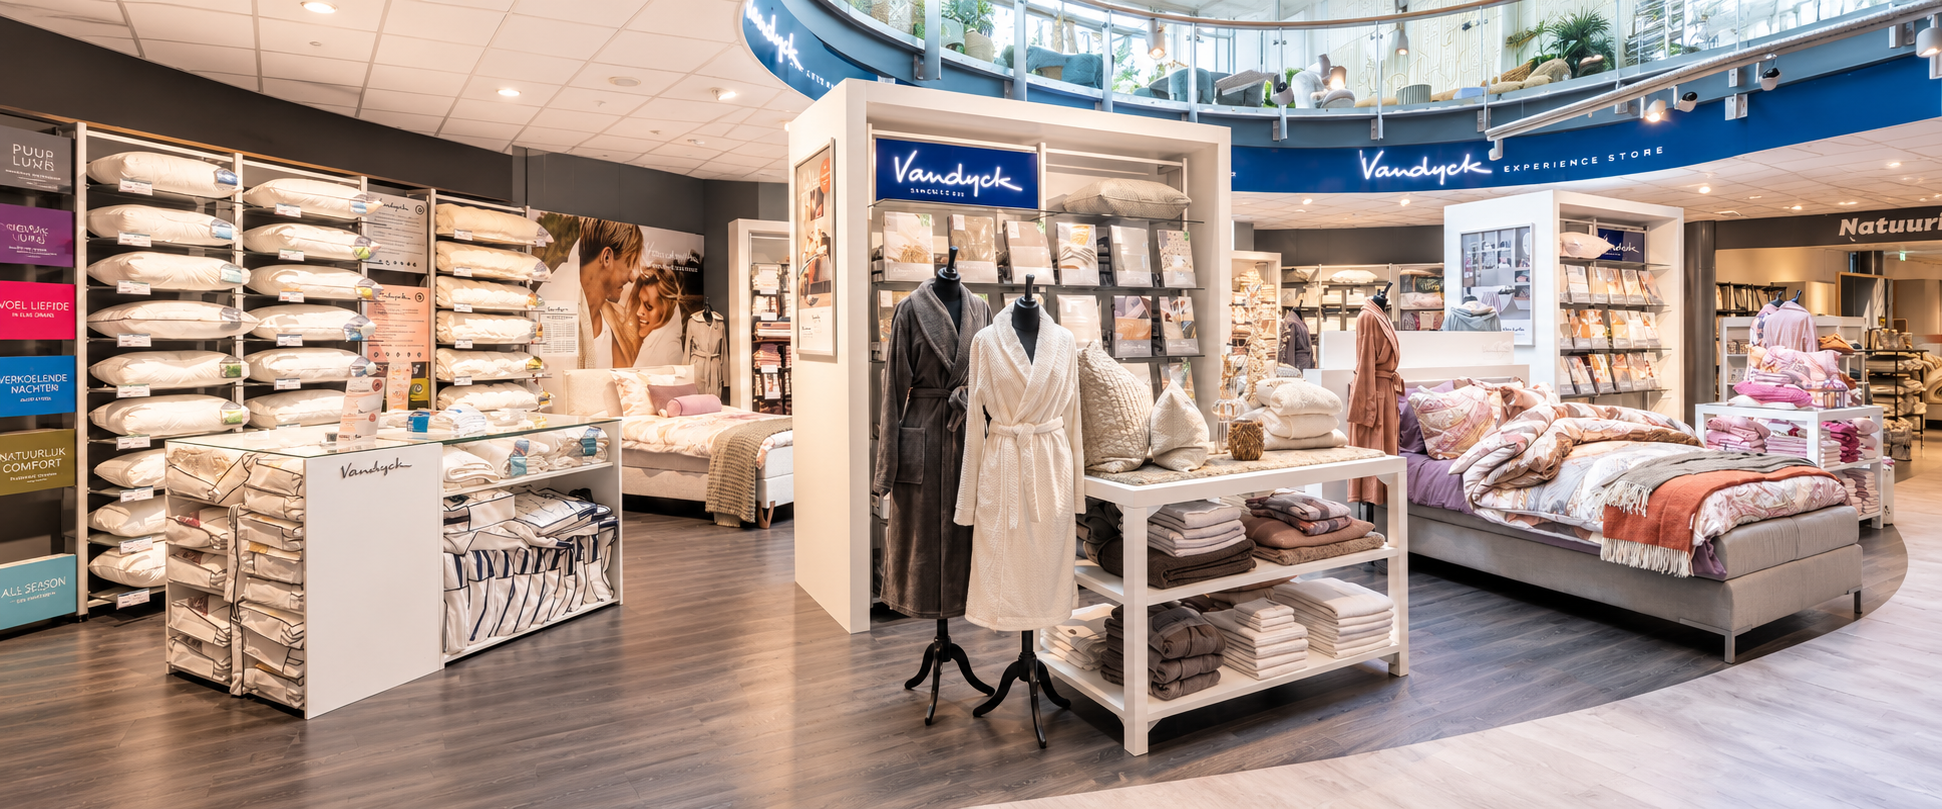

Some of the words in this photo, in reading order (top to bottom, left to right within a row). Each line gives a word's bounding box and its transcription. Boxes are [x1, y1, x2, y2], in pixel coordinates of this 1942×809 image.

[894, 150, 1023, 198] Vandyck
[1359, 149, 1493, 186] Vandyck
[1503, 156, 1598, 173] EXPERIENCE
[1608, 146, 1664, 162] STORE
[0, 373, 68, 385] VERKOELENDE
[2, 458, 62, 473] COMFORT
